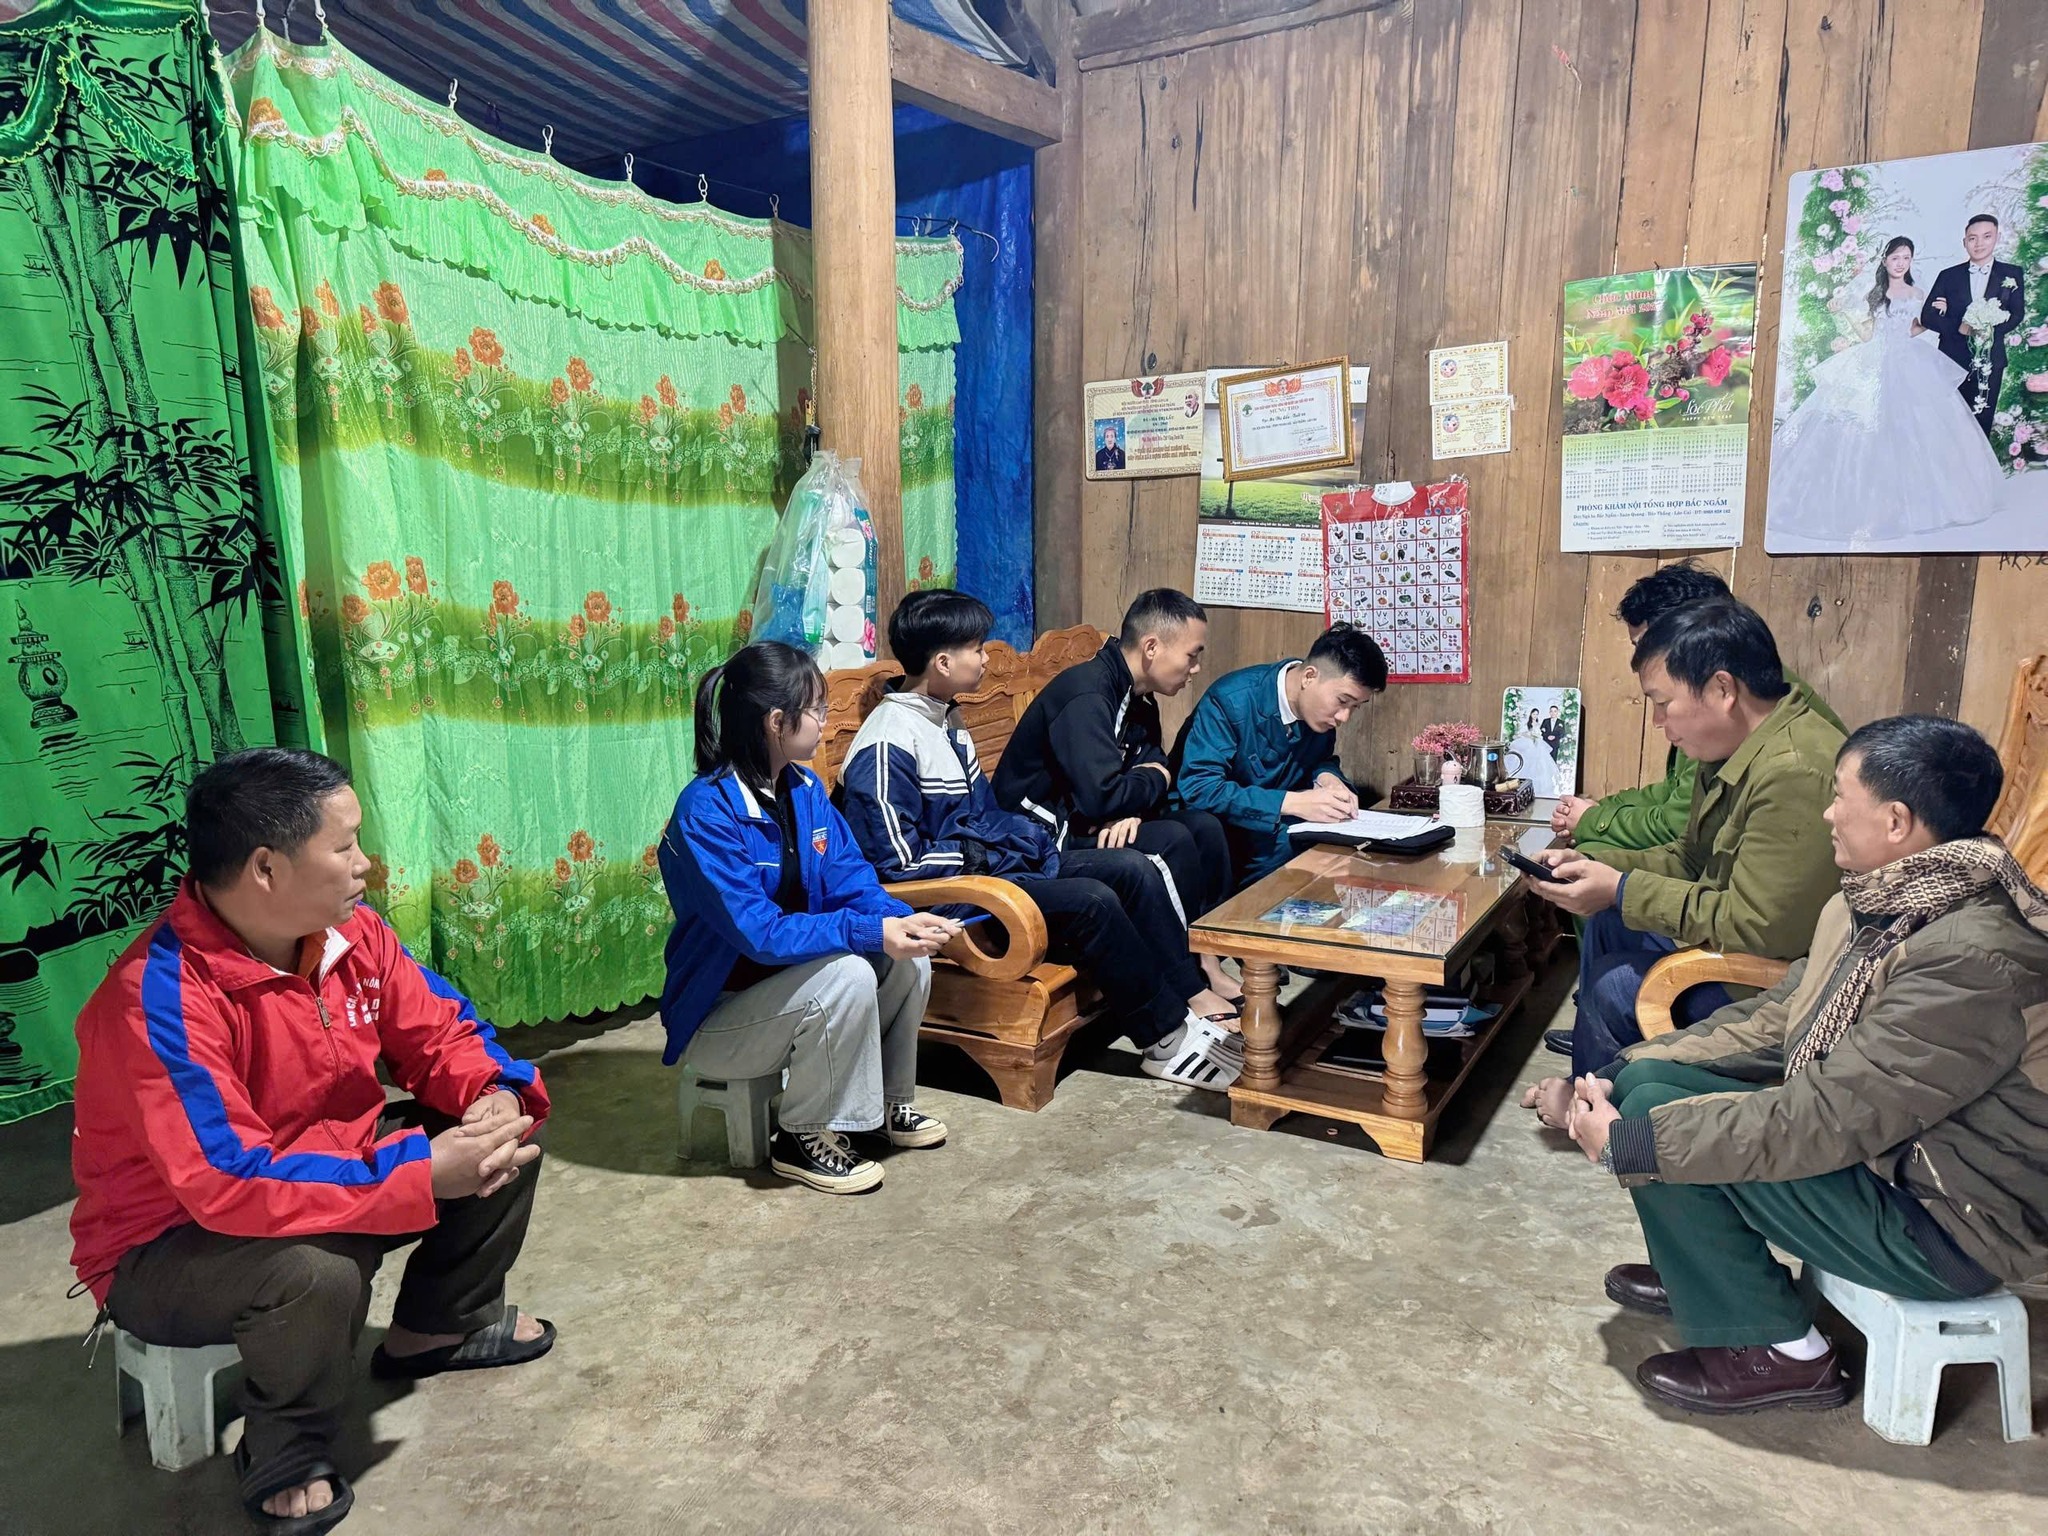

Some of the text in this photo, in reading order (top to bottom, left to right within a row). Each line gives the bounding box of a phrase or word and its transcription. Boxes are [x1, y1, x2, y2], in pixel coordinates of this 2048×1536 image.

[1418, 518, 1431, 526] Cc
[1419, 541, 1430, 549] Hh
[1397, 587, 1407, 595] Rr
[1419, 586, 1431, 594] Ss
[1397, 609, 1409, 617] Xx
[1419, 609, 1431, 617] Yy
[1376, 632, 1382, 640] 3
[1420, 631, 1426, 639] 5
[1442, 630, 1448, 639] 6
[1398, 653, 1407, 662] 10
